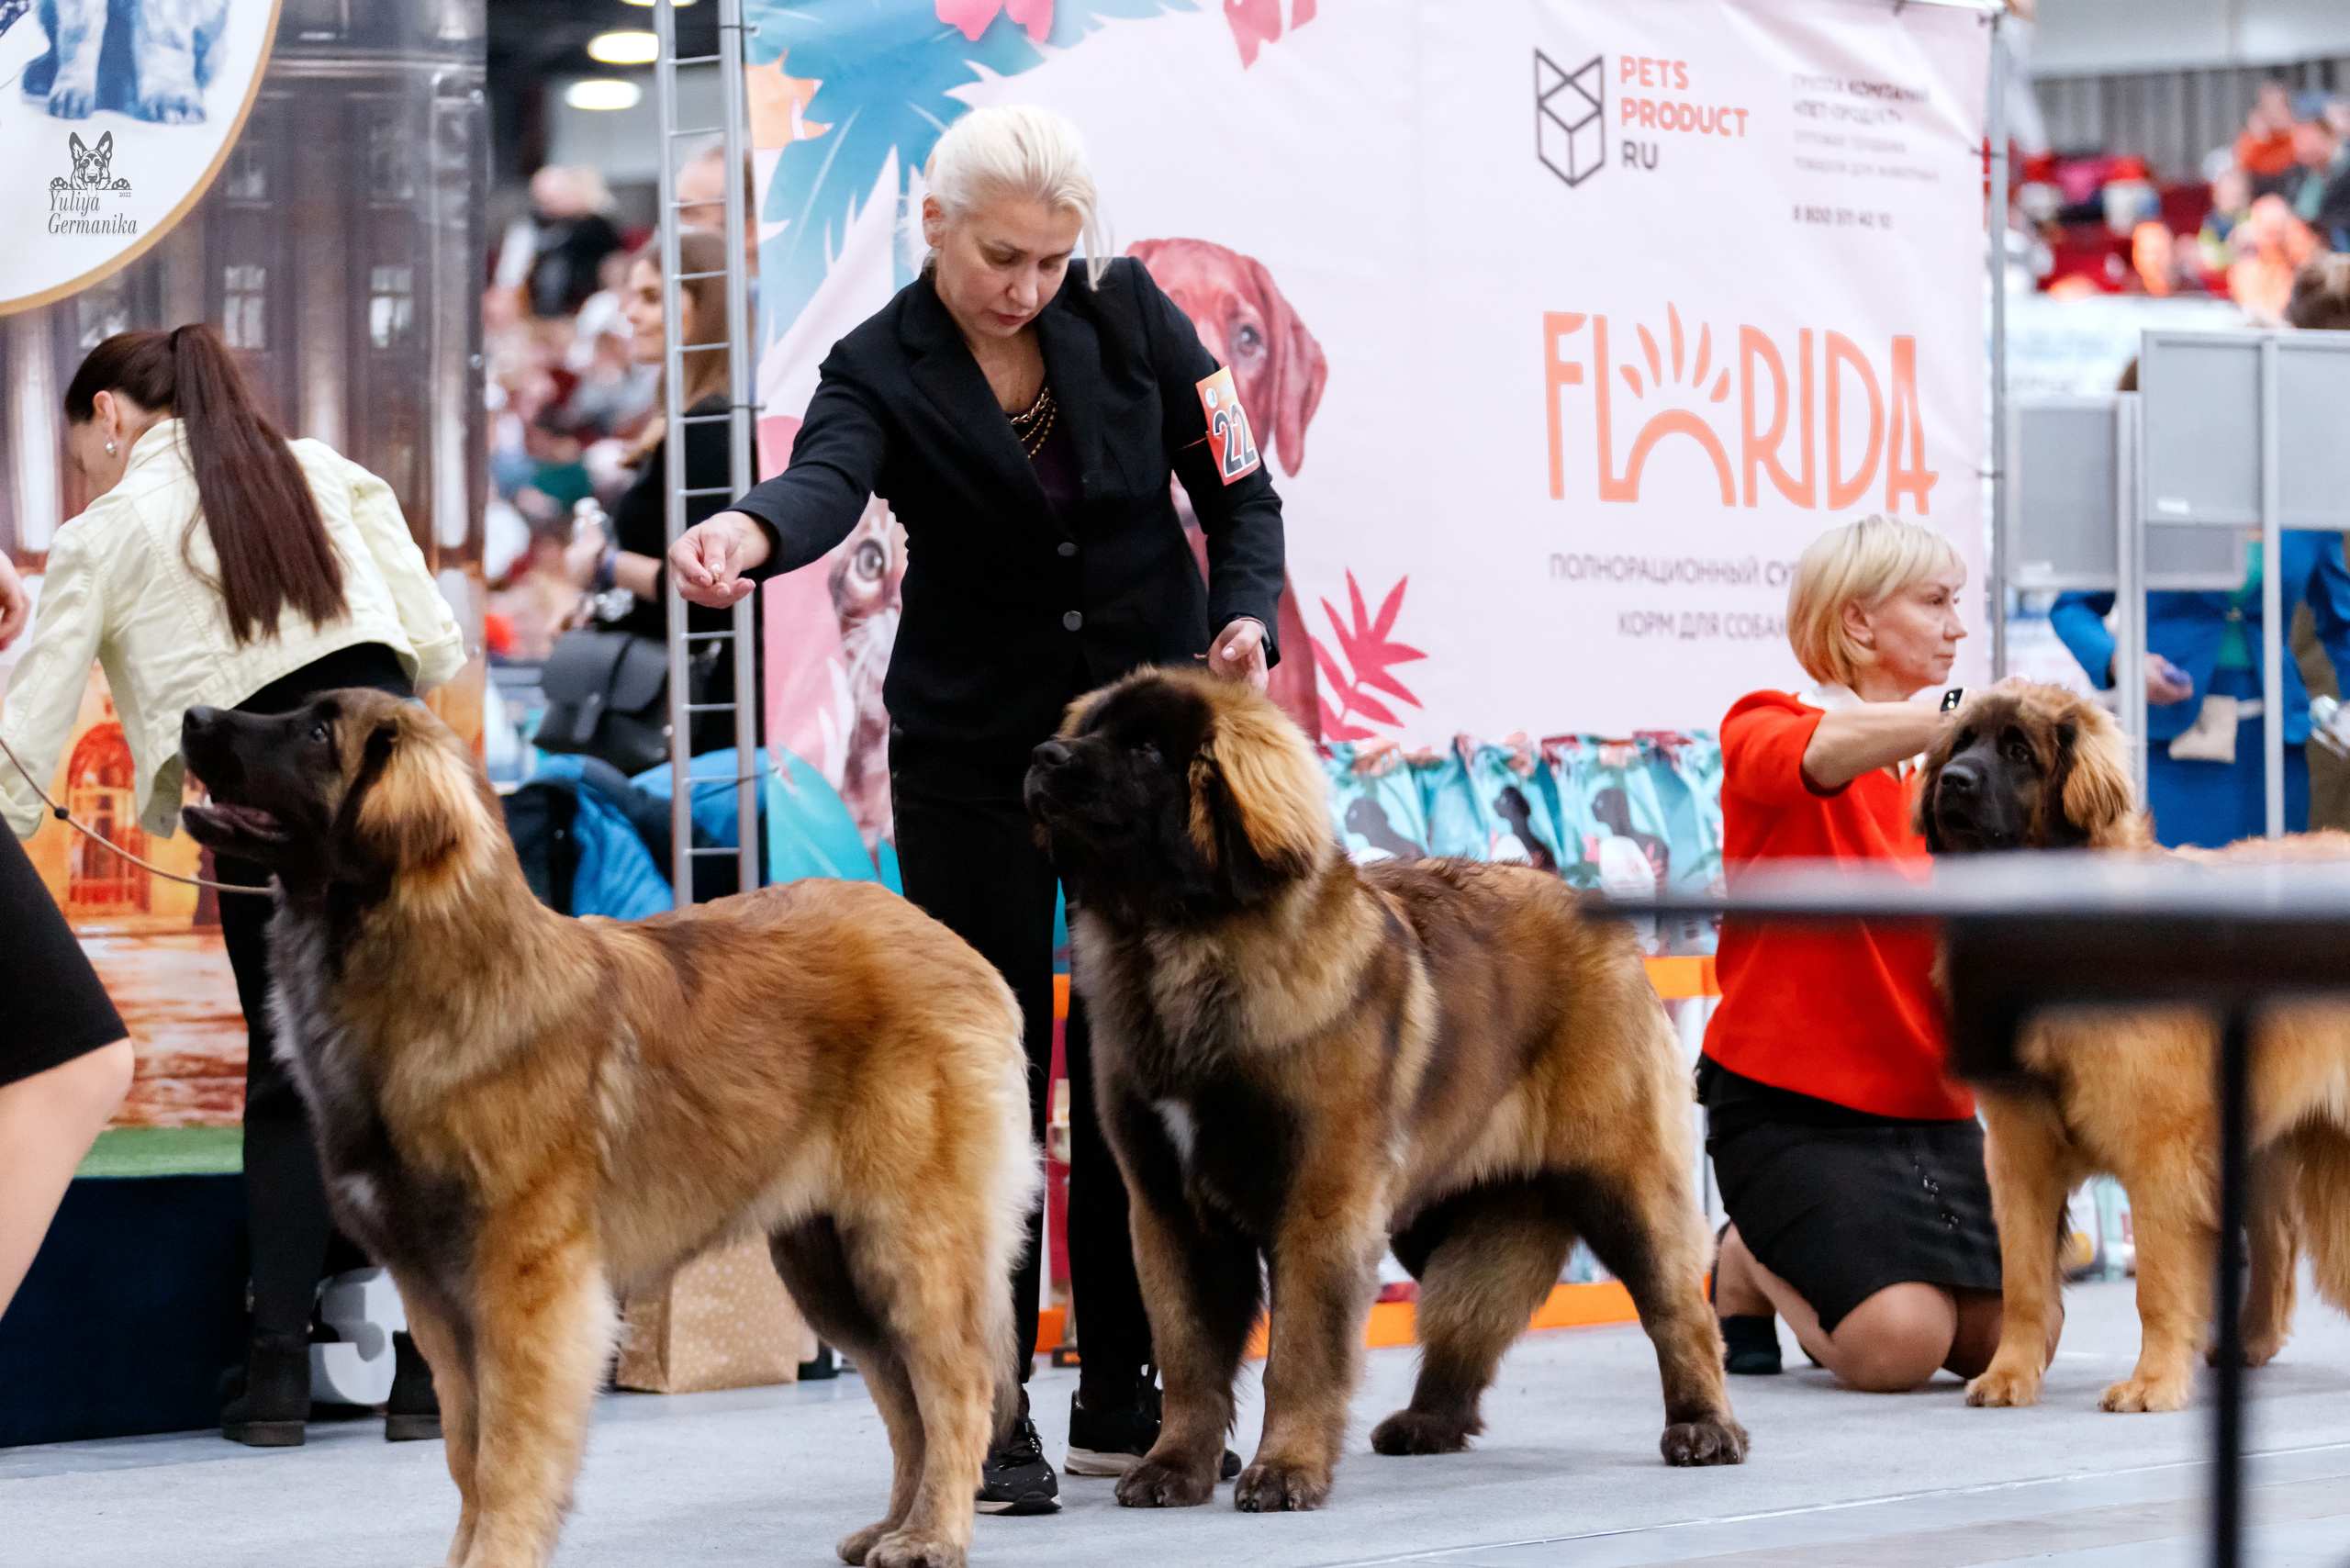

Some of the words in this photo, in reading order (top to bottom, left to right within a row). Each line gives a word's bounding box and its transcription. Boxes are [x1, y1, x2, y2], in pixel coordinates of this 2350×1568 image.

[1619, 55, 1689, 90] PETS
[1620, 97, 1750, 137] PRODUCT
[1622, 140, 1660, 171] RU
[1543, 301, 1939, 516] FLORIDA
[1214, 402, 1259, 477] 22
[1617, 610, 1676, 638] КОРМ
[1679, 610, 1720, 641] ДЛЯ
